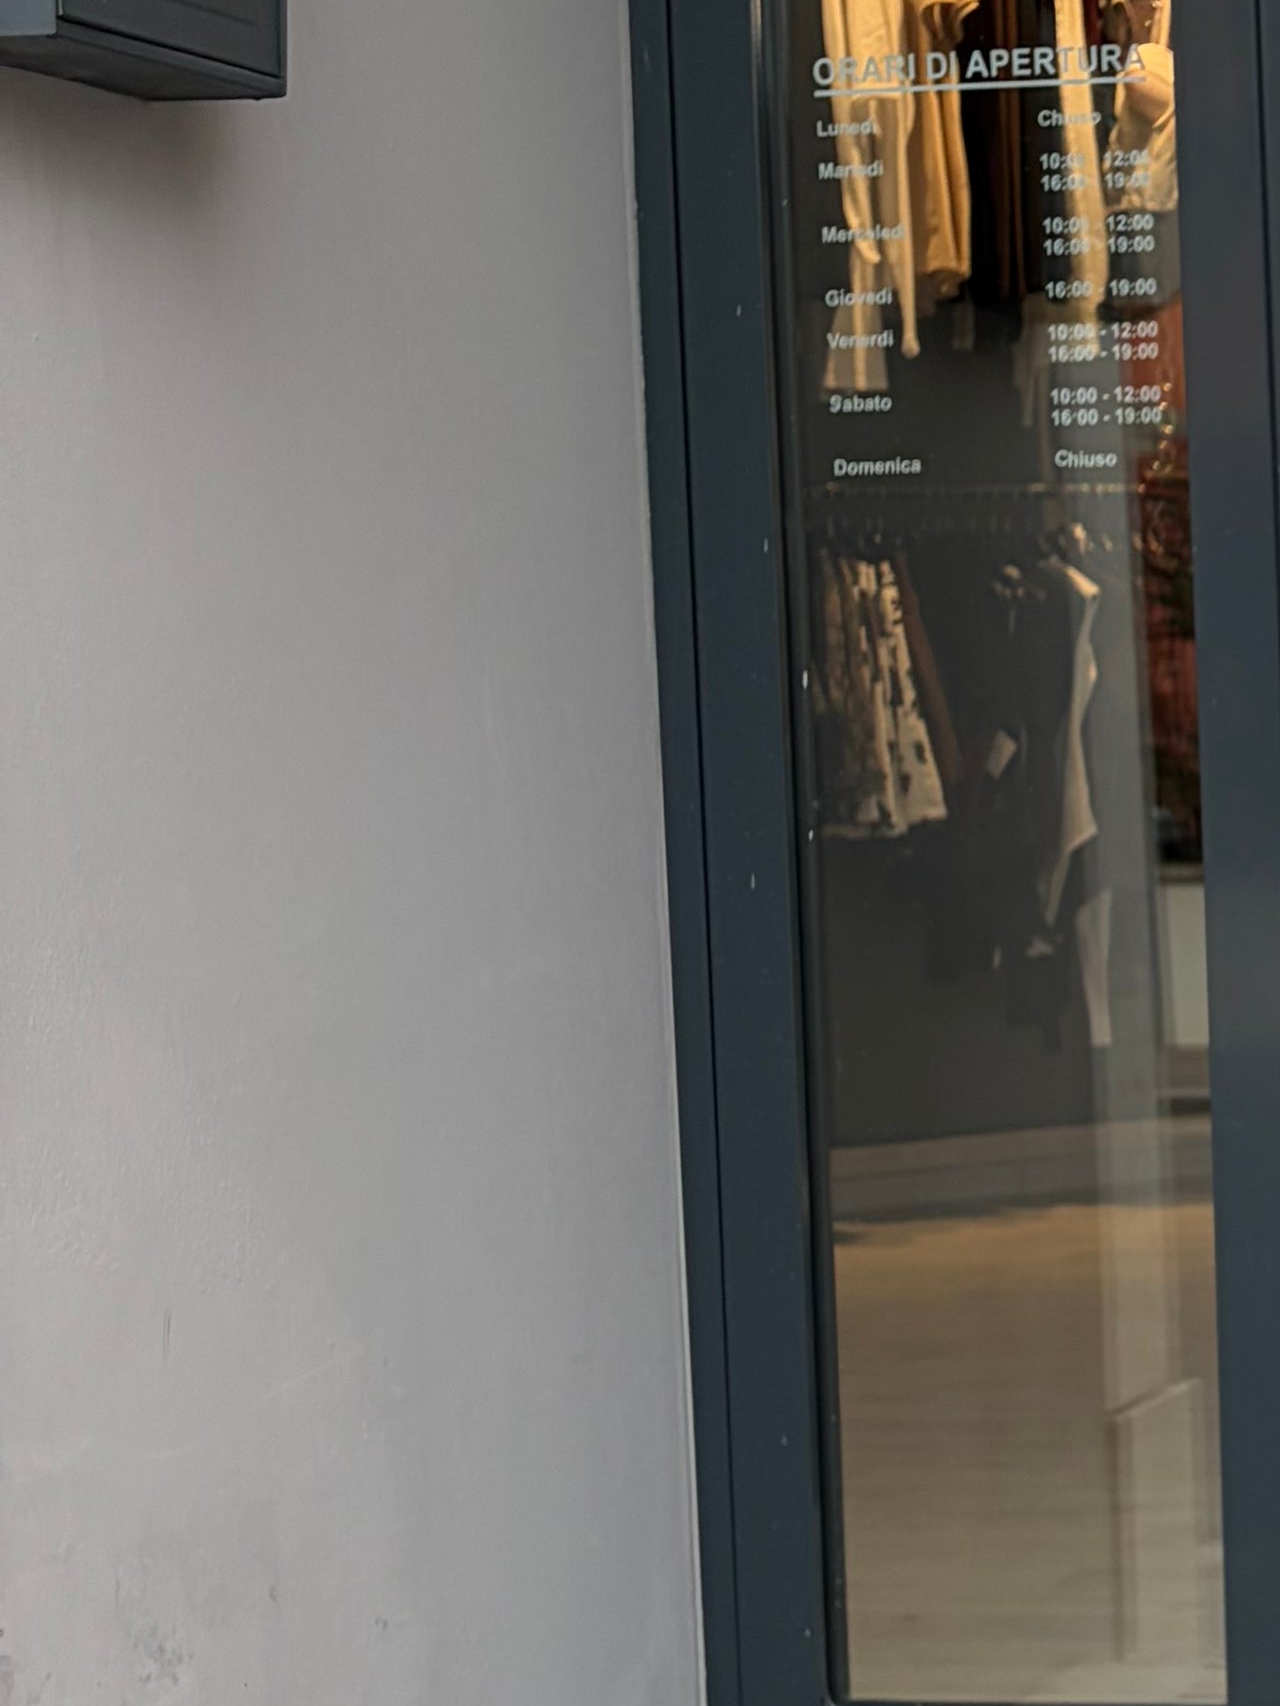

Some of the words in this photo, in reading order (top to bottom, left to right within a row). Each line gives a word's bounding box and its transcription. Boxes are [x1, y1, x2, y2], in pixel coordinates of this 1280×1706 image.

[812, 52, 916, 87] ORARI
[926, 50, 958, 80] DI
[964, 43, 1147, 80] APERTURA
[1106, 213, 1155, 232] 12:00
[1107, 235, 1155, 253] 19:00
[1045, 280, 1091, 299] 16:00
[1109, 277, 1157, 297] 19:00
[1047, 323, 1094, 342] 10:00
[1111, 320, 1159, 339] 12:00
[1048, 345, 1095, 363] 16:00
[1112, 342, 1159, 361] 19:00
[829, 394, 892, 414] Sabato
[1050, 386, 1097, 406] 10:00
[1113, 385, 1161, 404] 12:00
[1051, 408, 1098, 427] 16:00
[1114, 406, 1162, 425] 19:00
[833, 456, 922, 478] Domenica
[1054, 448, 1117, 469] Chiuso
